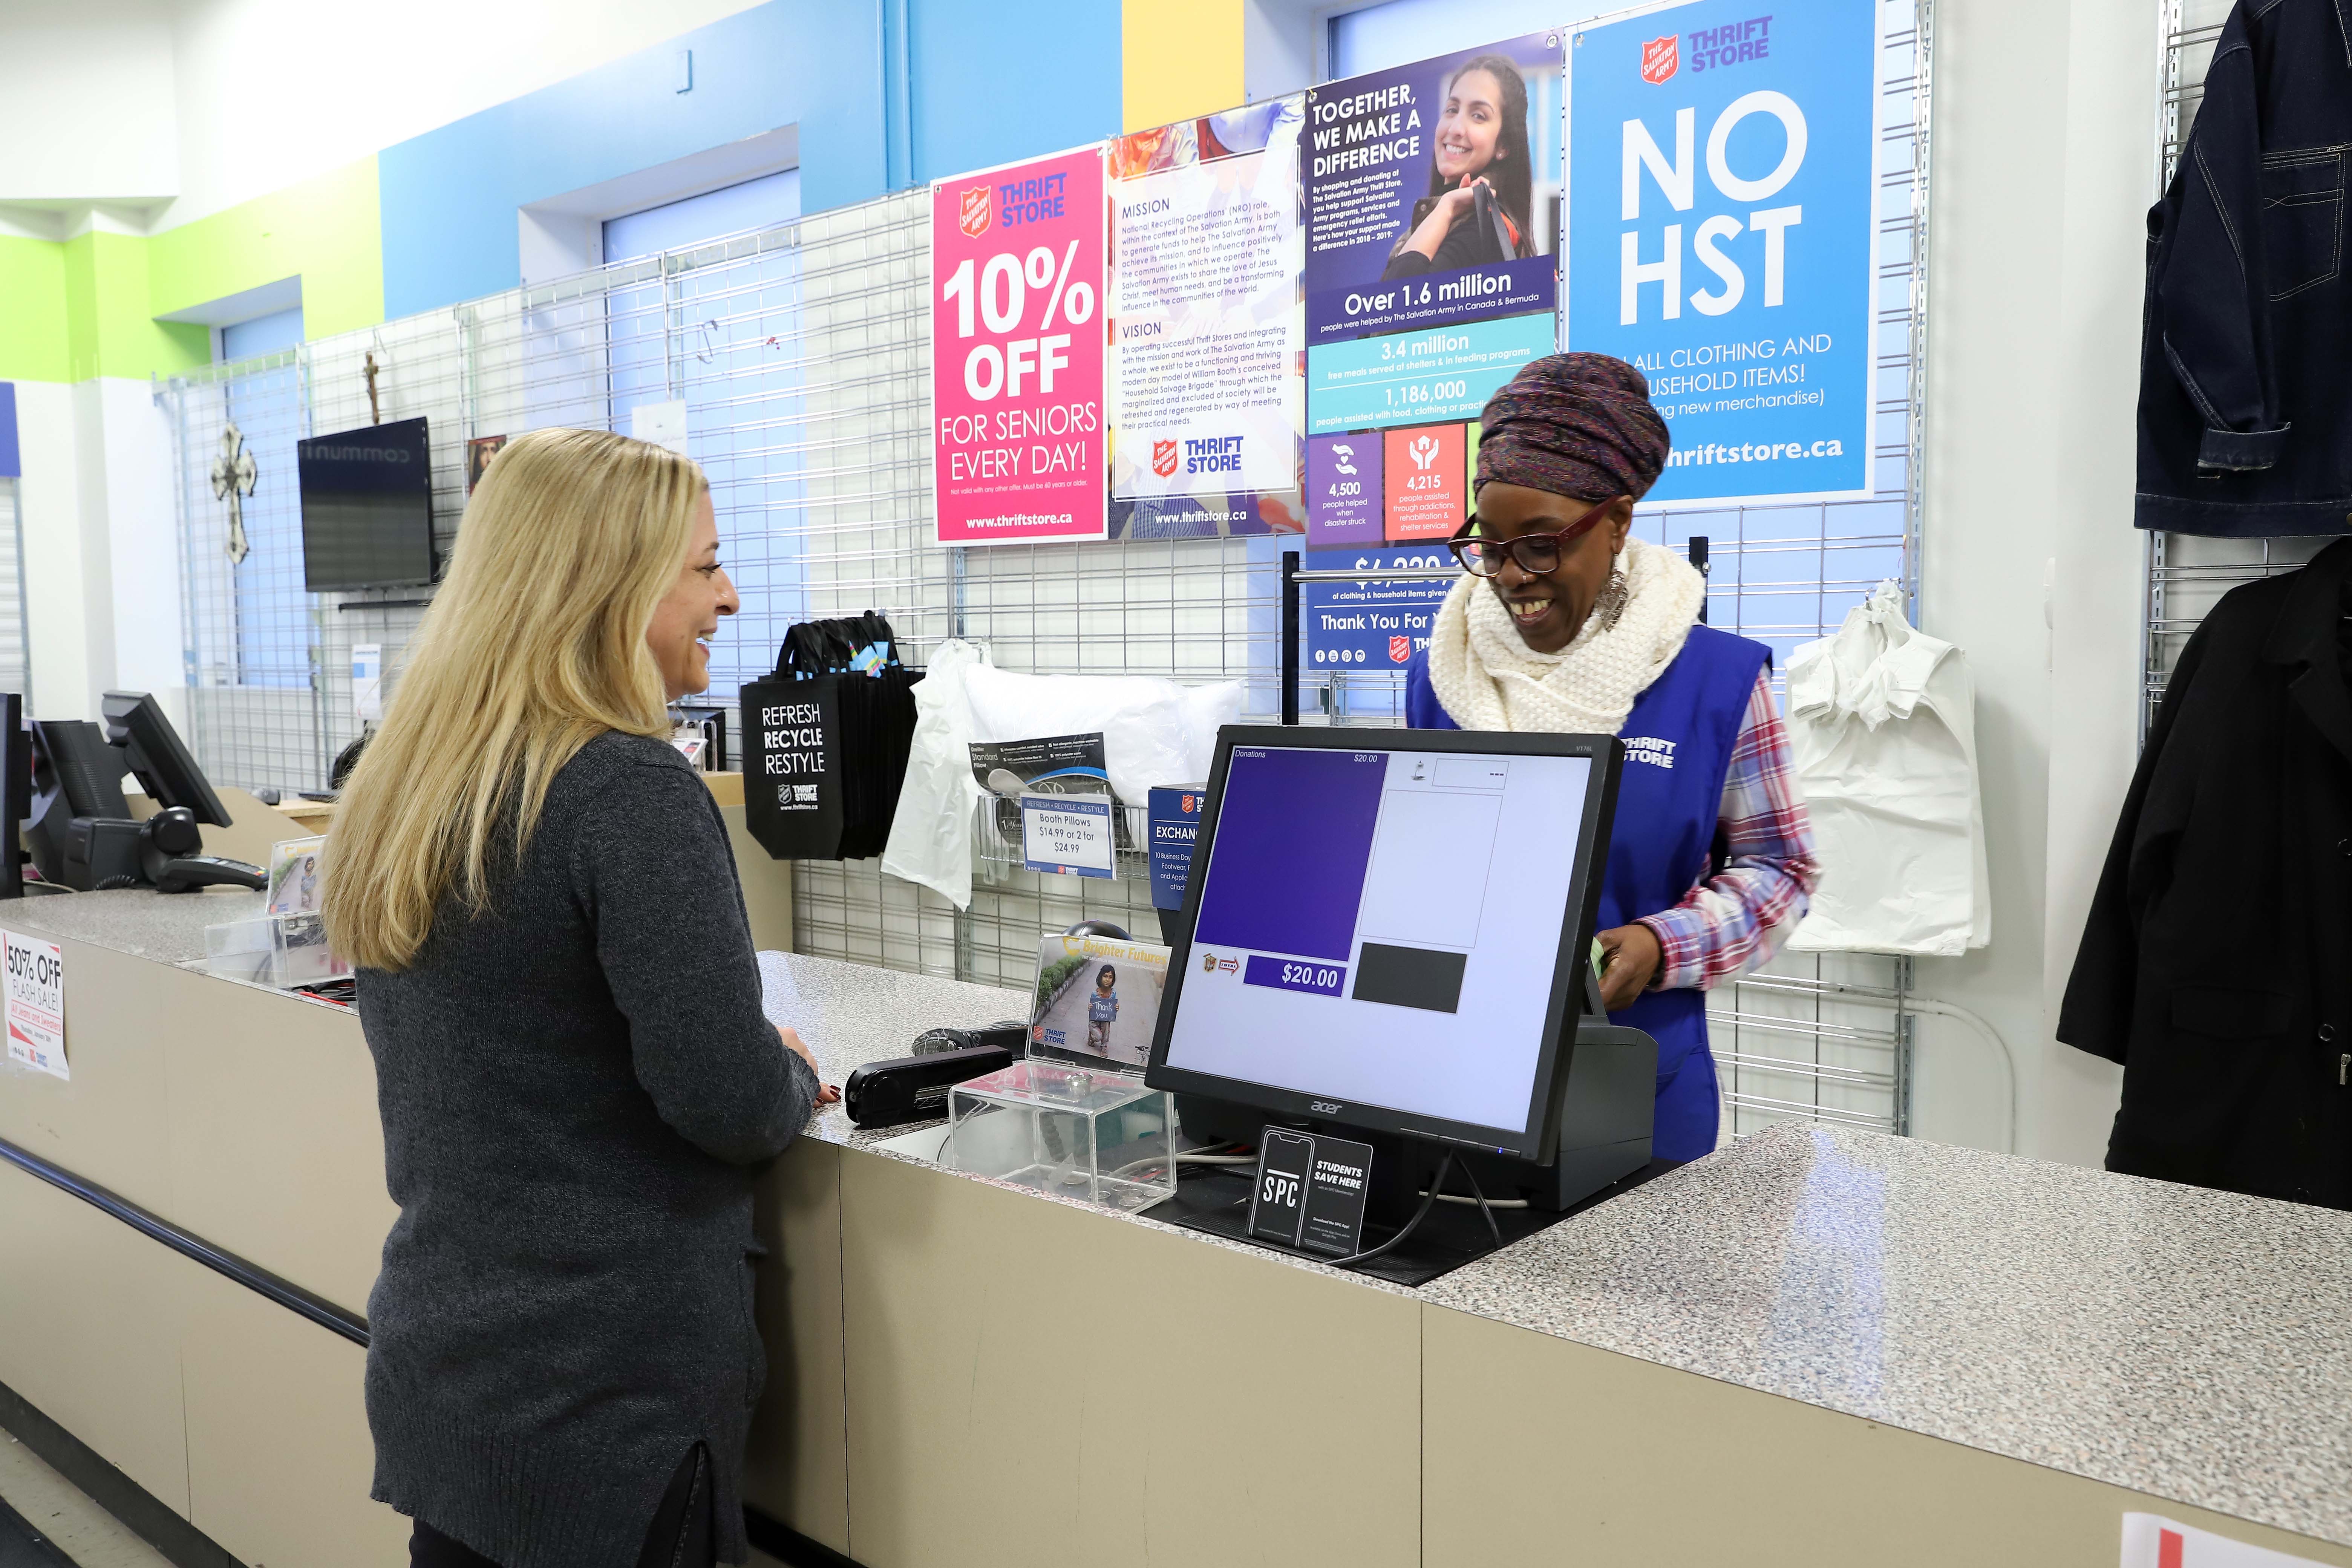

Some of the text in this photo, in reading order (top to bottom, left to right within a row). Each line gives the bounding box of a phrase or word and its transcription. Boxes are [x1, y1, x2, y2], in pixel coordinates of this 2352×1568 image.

[1689, 15, 1772, 52] THRIFT
[1643, 42, 1675, 76] SALVATION
[1648, 42, 1663, 59] THE
[1692, 38, 1769, 72] STORE
[1655, 55, 1674, 80] ARMY
[1313, 84, 1415, 125] TOGETHER,
[1314, 109, 1421, 150] WE MAKE A
[1314, 136, 1419, 177] DIFFERENCE
[1622, 90, 1808, 221] NO
[999, 172, 1067, 205] THRIFT
[962, 193, 988, 227] SALVATION
[966, 192, 978, 210] THE
[1002, 196, 1064, 227] STORE
[1122, 198, 1169, 219] MISSION
[971, 207, 988, 232] ARMY
[1621, 205, 1801, 325] HST
[944, 240, 1094, 338] 10%
[1344, 273, 1511, 315] Over 1.6 million
[1321, 323, 1342, 333] people
[1361, 316, 1383, 326] helped
[1407, 309, 1436, 319] Salvation
[1465, 300, 1495, 310] Canada
[1505, 294, 1539, 305] Bermuda
[1123, 322, 1161, 338] VISION
[1131, 343, 1160, 354] operating
[1162, 337, 1194, 348] successful
[1196, 335, 1210, 344] Thrift
[1234, 331, 1247, 339] and
[1249, 326, 1286, 337] integrating
[1382, 335, 1468, 360] 3.4 million
[1635, 334, 1831, 371] ALL CLOTHING AND
[965, 334, 1070, 401] OFF
[1648, 364, 1804, 397] USEHOLD ITEMS!
[1386, 380, 1465, 406] 1,186,000
[1680, 403, 1711, 415] new
[1716, 389, 1824, 411] merchandise)
[942, 402, 1096, 445] FOR SENIORS
[1154, 445, 1176, 469] SALVATION
[1157, 443, 1167, 456] THE
[1185, 436, 1243, 456] THRIFT
[1664, 439, 1843, 467] hriftstore.ca
[952, 441, 1085, 480] EVERY DAY!
[1161, 456, 1175, 474] ARMY
[1187, 454, 1241, 473] STORE
[1329, 482, 1360, 497] 4,500
[1407, 475, 1440, 491] 4,215
[1323, 498, 1367, 509] people helped
[1393, 504, 1418, 513] through
[1400, 495, 1423, 503] people
[966, 514, 1072, 528] www.thriftstore.ca
[1155, 510, 1247, 524] www.thriftstore.ca
[1400, 513, 1441, 521] rehabilitation
[1428, 590, 1446, 598] given
[1321, 614, 1366, 629] Thank
[1370, 614, 1398, 629] You
[1405, 613, 1427, 628] For
[763, 703, 820, 726] REFRESH
[764, 728, 822, 749] RECYCLE
[766, 752, 825, 774] RESTYLE
[792, 785, 817, 794] THRIFT
[1040, 813, 1090, 827] Booth Pillows
[1040, 827, 1063, 837] $14.99
[1077, 831, 1081, 839] 2
[1084, 831, 1094, 840] for
[1156, 827, 1197, 840] EXCHAN
[1055, 842, 1079, 853] $24.99
[1084, 940, 1166, 964] Brighter Futures
[9, 946, 60, 989] 50% OFF
[1282, 963, 1337, 988] $20.00
[1092, 1001, 1113, 1012] Thank
[1044, 1035, 1065, 1044] STORE
[1045, 1029, 1066, 1038] THRIFT
[1311, 1101, 1342, 1114] acer
[1317, 1161, 1362, 1177] STUDENTS
[1314, 1172, 1362, 1189] SAVE HERE
